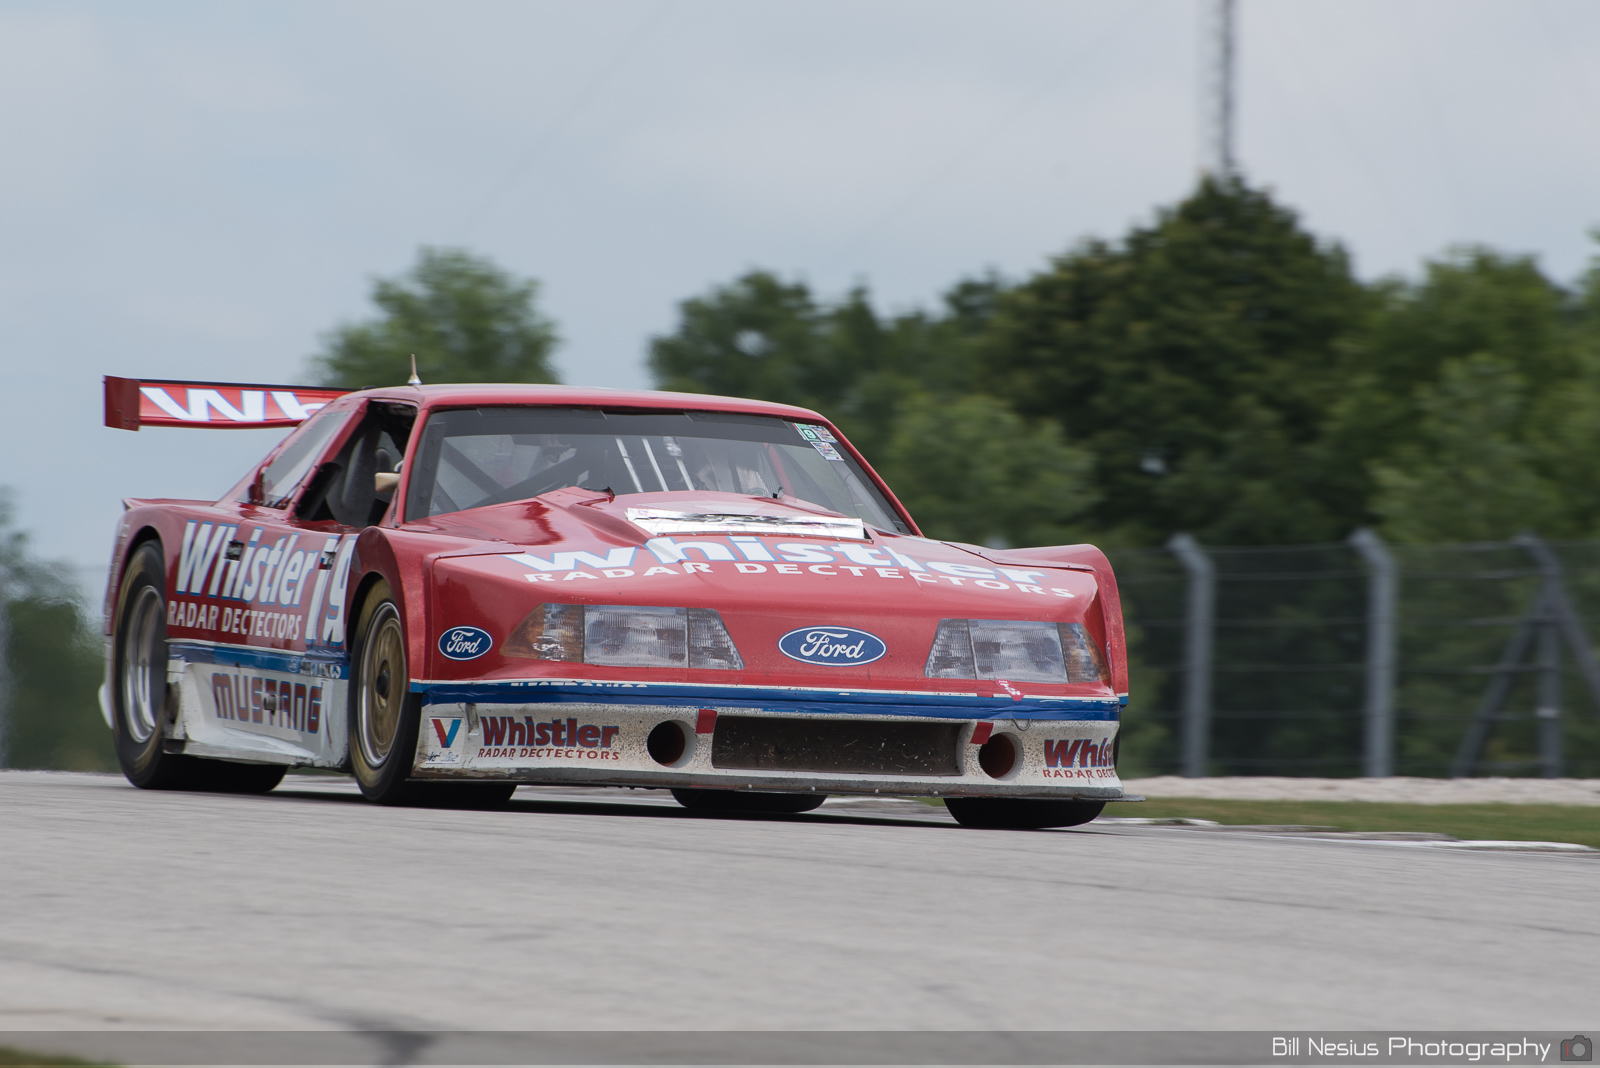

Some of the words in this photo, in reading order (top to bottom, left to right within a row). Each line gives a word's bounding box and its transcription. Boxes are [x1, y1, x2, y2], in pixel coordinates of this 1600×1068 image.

[176, 519, 319, 608] Whistler
[499, 536, 1049, 584] Whistler
[524, 562, 713, 582] RADAR
[734, 562, 1075, 598] DECTECTORS
[167, 601, 219, 631] RADAR
[221, 607, 302, 641] DECTECTORS
[446, 630, 482, 654] Ford
[800, 632, 864, 659] Ford
[212, 673, 322, 734] MUSTANG
[480, 716, 619, 748] Whistler
[478, 748, 515, 758] RADAR
[519, 748, 619, 760] DECTECTORS
[1042, 769, 1094, 778] RADAR
